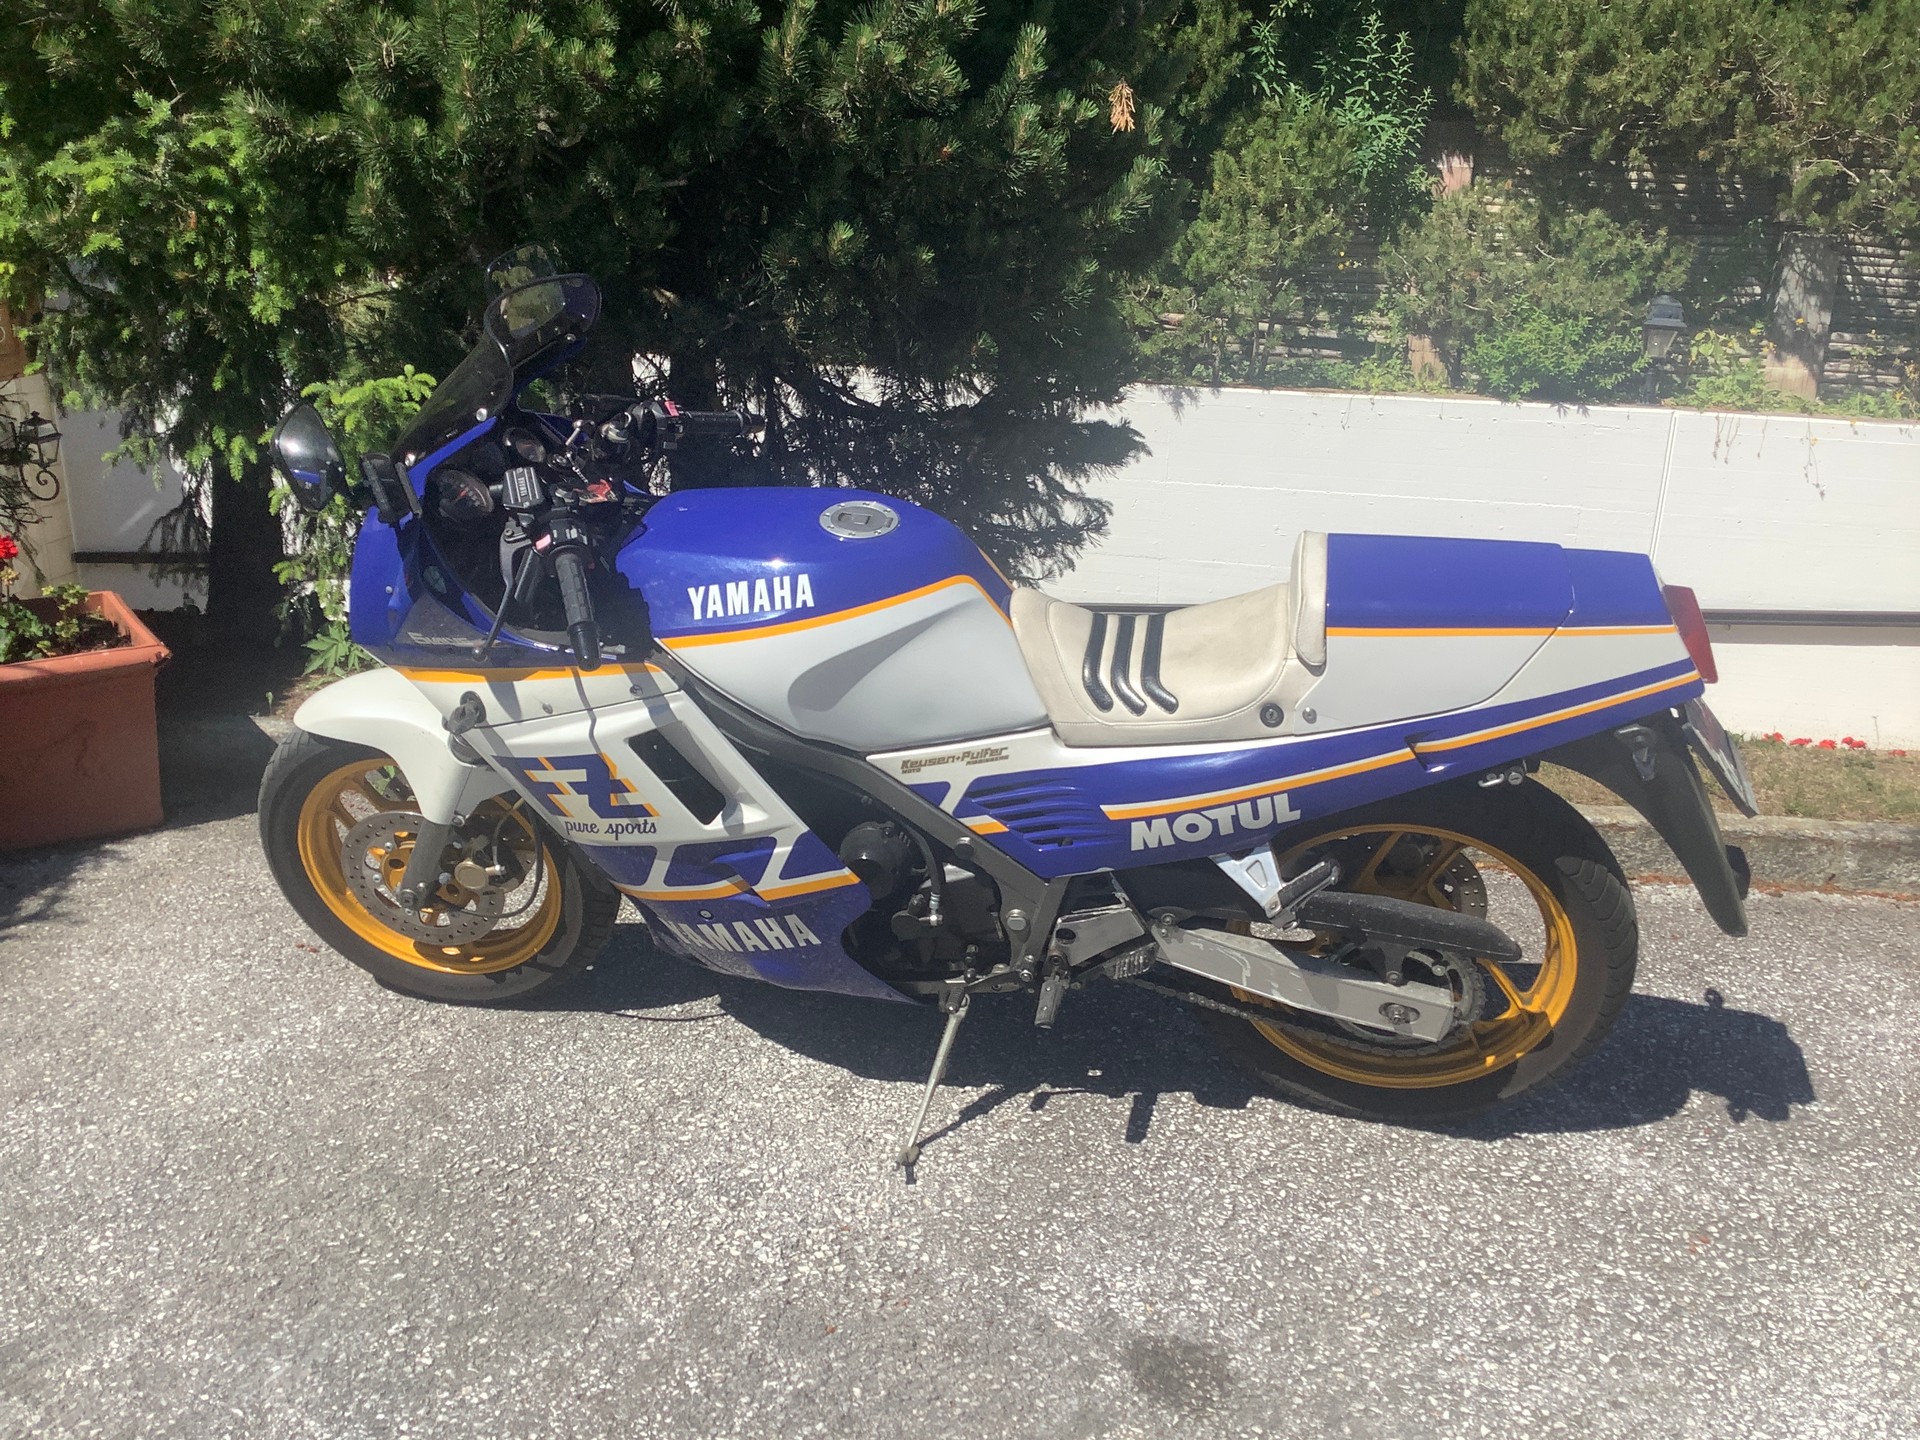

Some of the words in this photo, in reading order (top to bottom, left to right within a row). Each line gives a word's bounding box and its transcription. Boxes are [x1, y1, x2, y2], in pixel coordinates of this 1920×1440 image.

[687, 573, 815, 620] YAMAHA
[565, 821, 599, 835] pure
[604, 819, 657, 840] sports
[1131, 793, 1301, 851] MOTUL
[657, 913, 822, 952] YAMAHA
